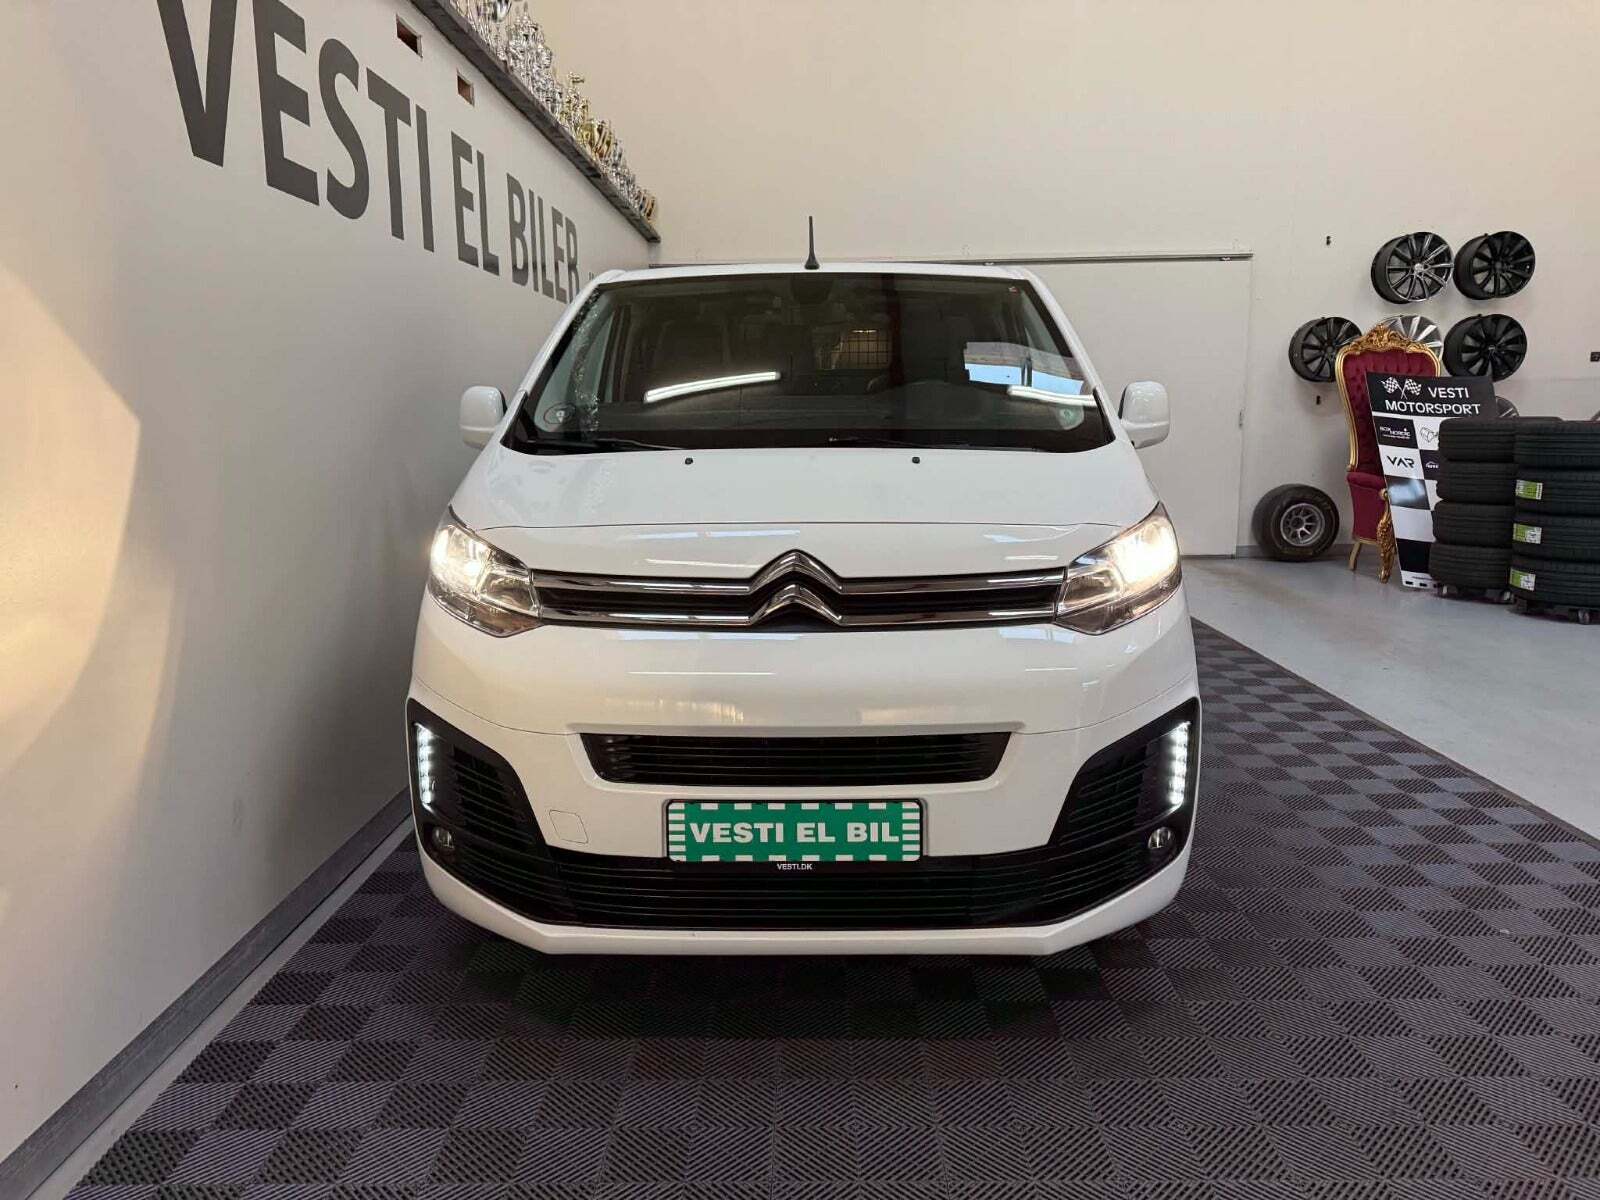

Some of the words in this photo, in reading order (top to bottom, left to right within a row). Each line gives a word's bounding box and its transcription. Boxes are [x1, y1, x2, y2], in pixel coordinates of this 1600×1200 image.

[157, 0, 434, 252] VESTI
[451, 131, 499, 275] EL
[507, 172, 579, 304] BILER
[1428, 387, 1469, 398] VESTI
[1385, 400, 1480, 414] MOTORSPORT
[1386, 455, 1415, 468] VAR
[689, 822, 784, 843] VESTI
[797, 822, 835, 842] EL
[846, 822, 899, 842] BIL
